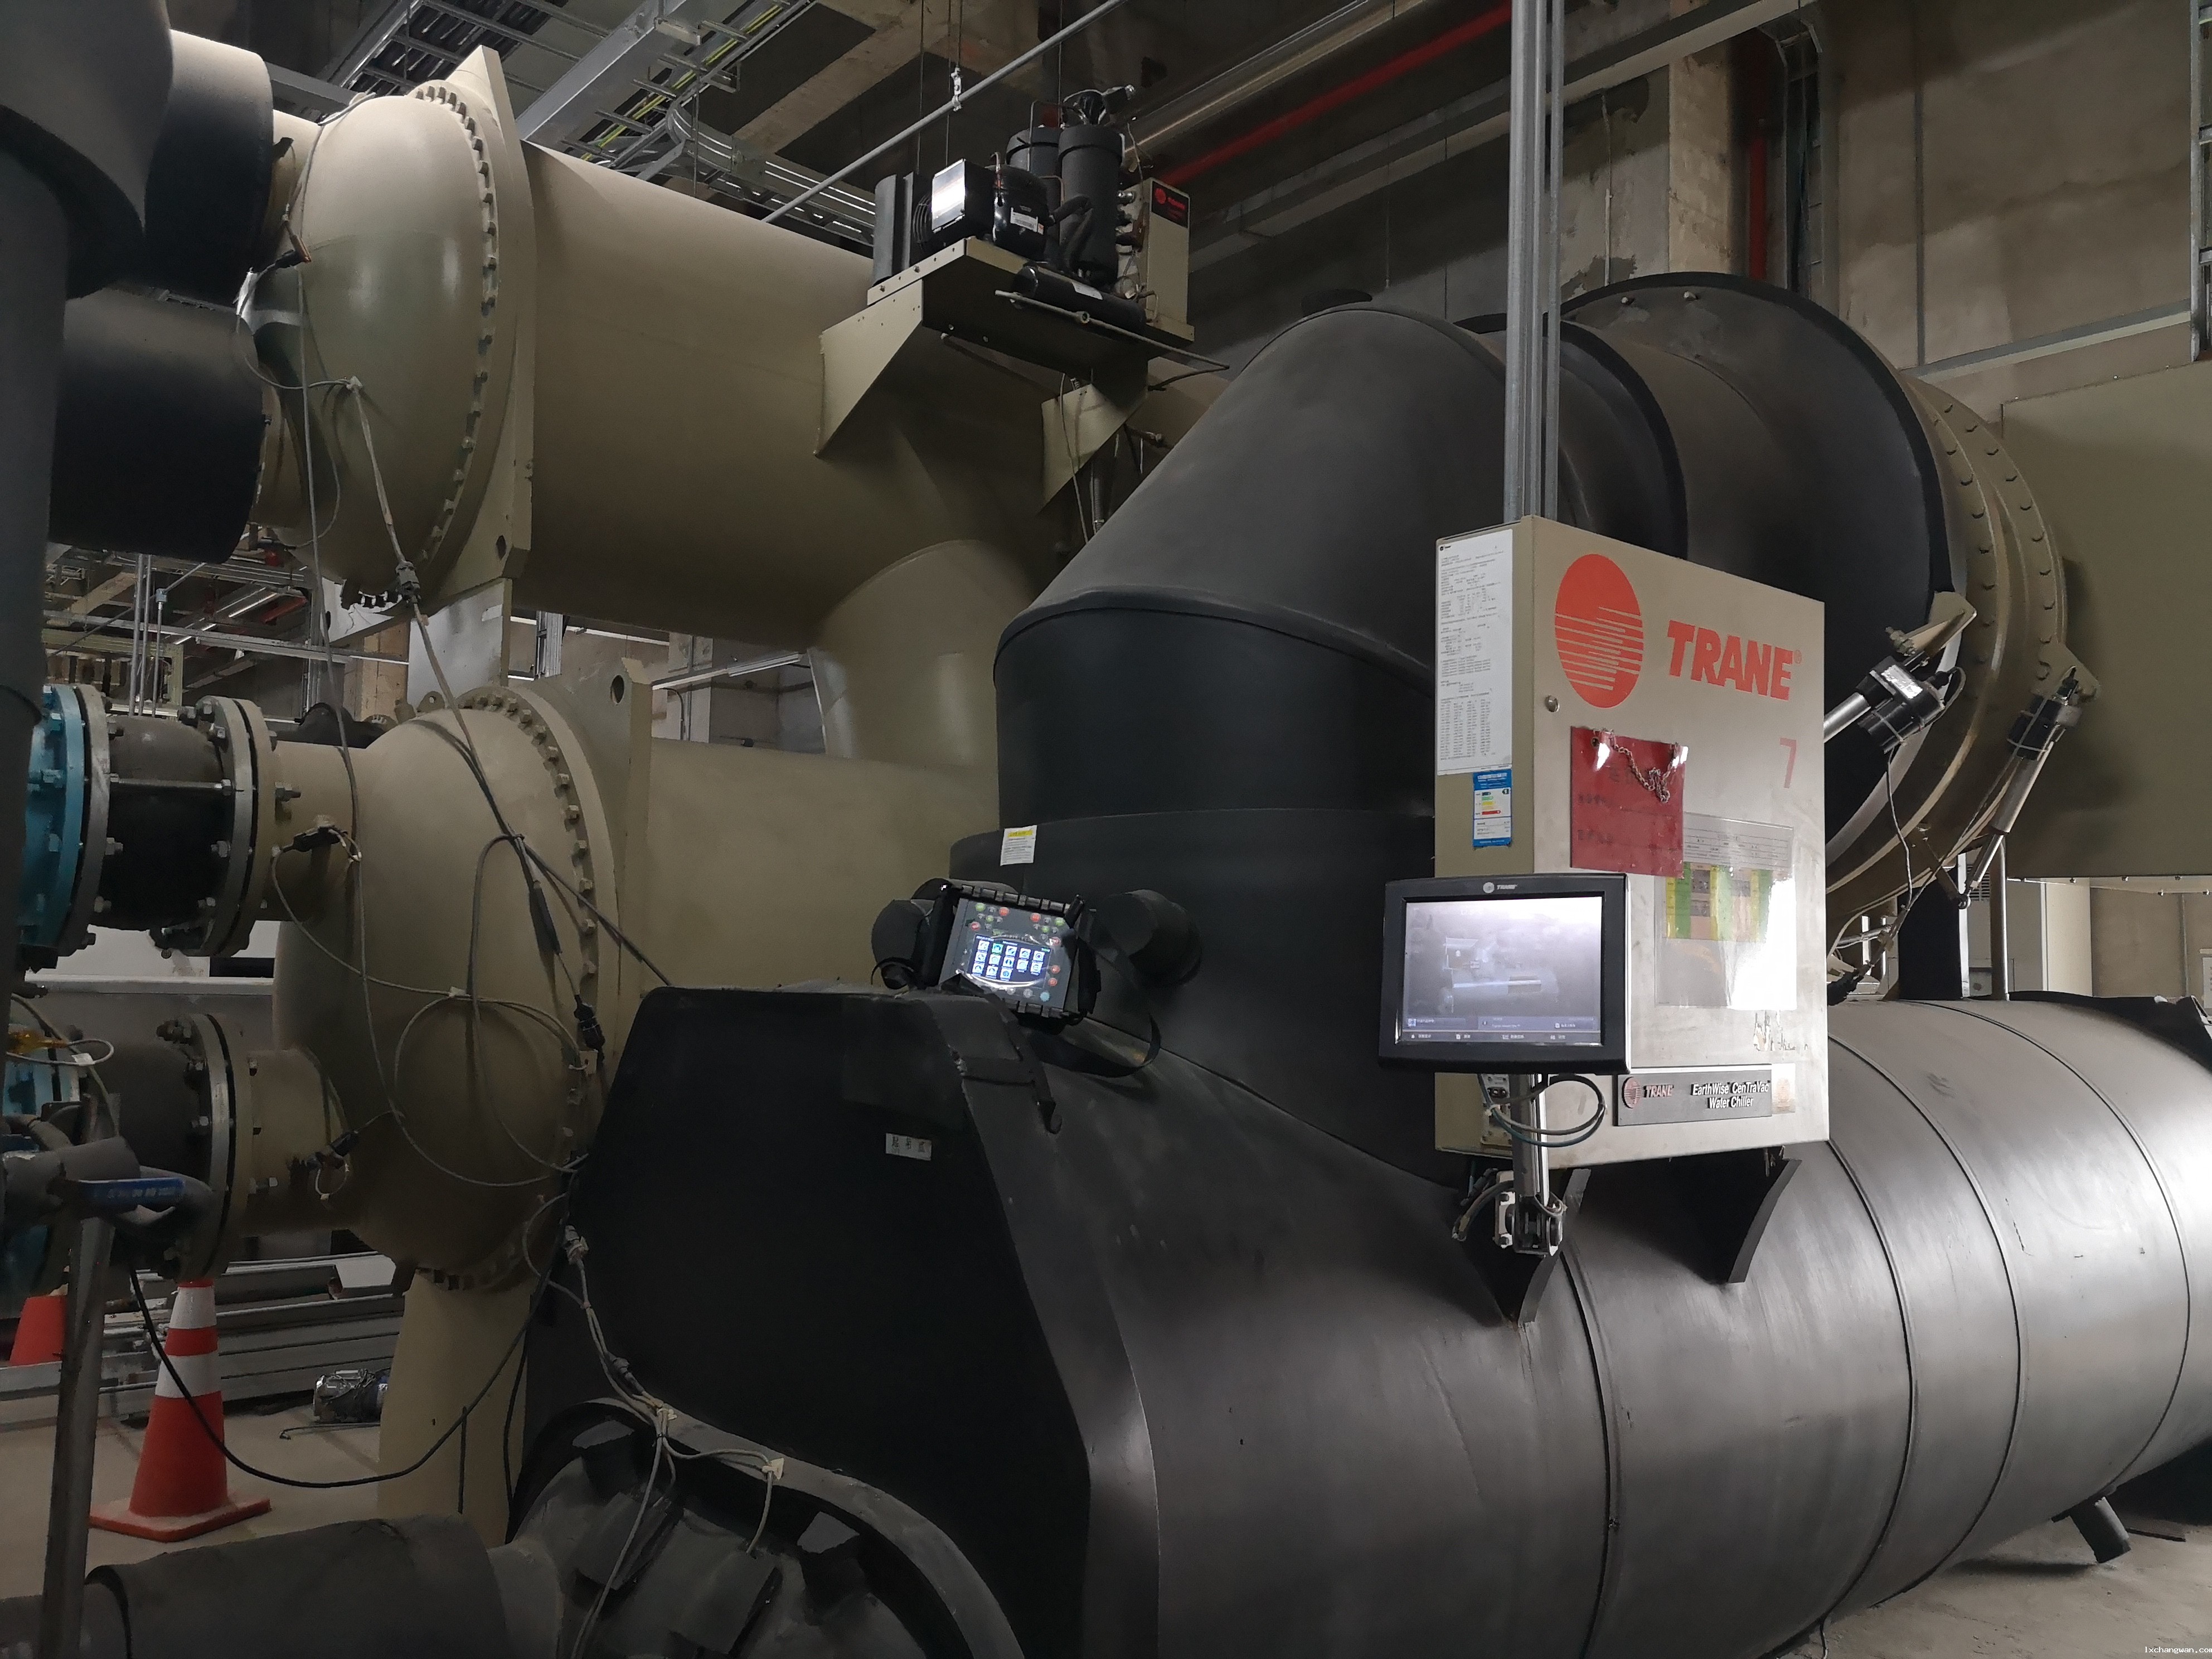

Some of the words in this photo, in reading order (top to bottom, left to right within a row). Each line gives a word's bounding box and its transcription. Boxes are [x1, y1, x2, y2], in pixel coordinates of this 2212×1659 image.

[1780, 738, 1797, 788] 7
[1709, 1097, 1730, 1109] Water
[1730, 1096, 1754, 1108] Chiller
